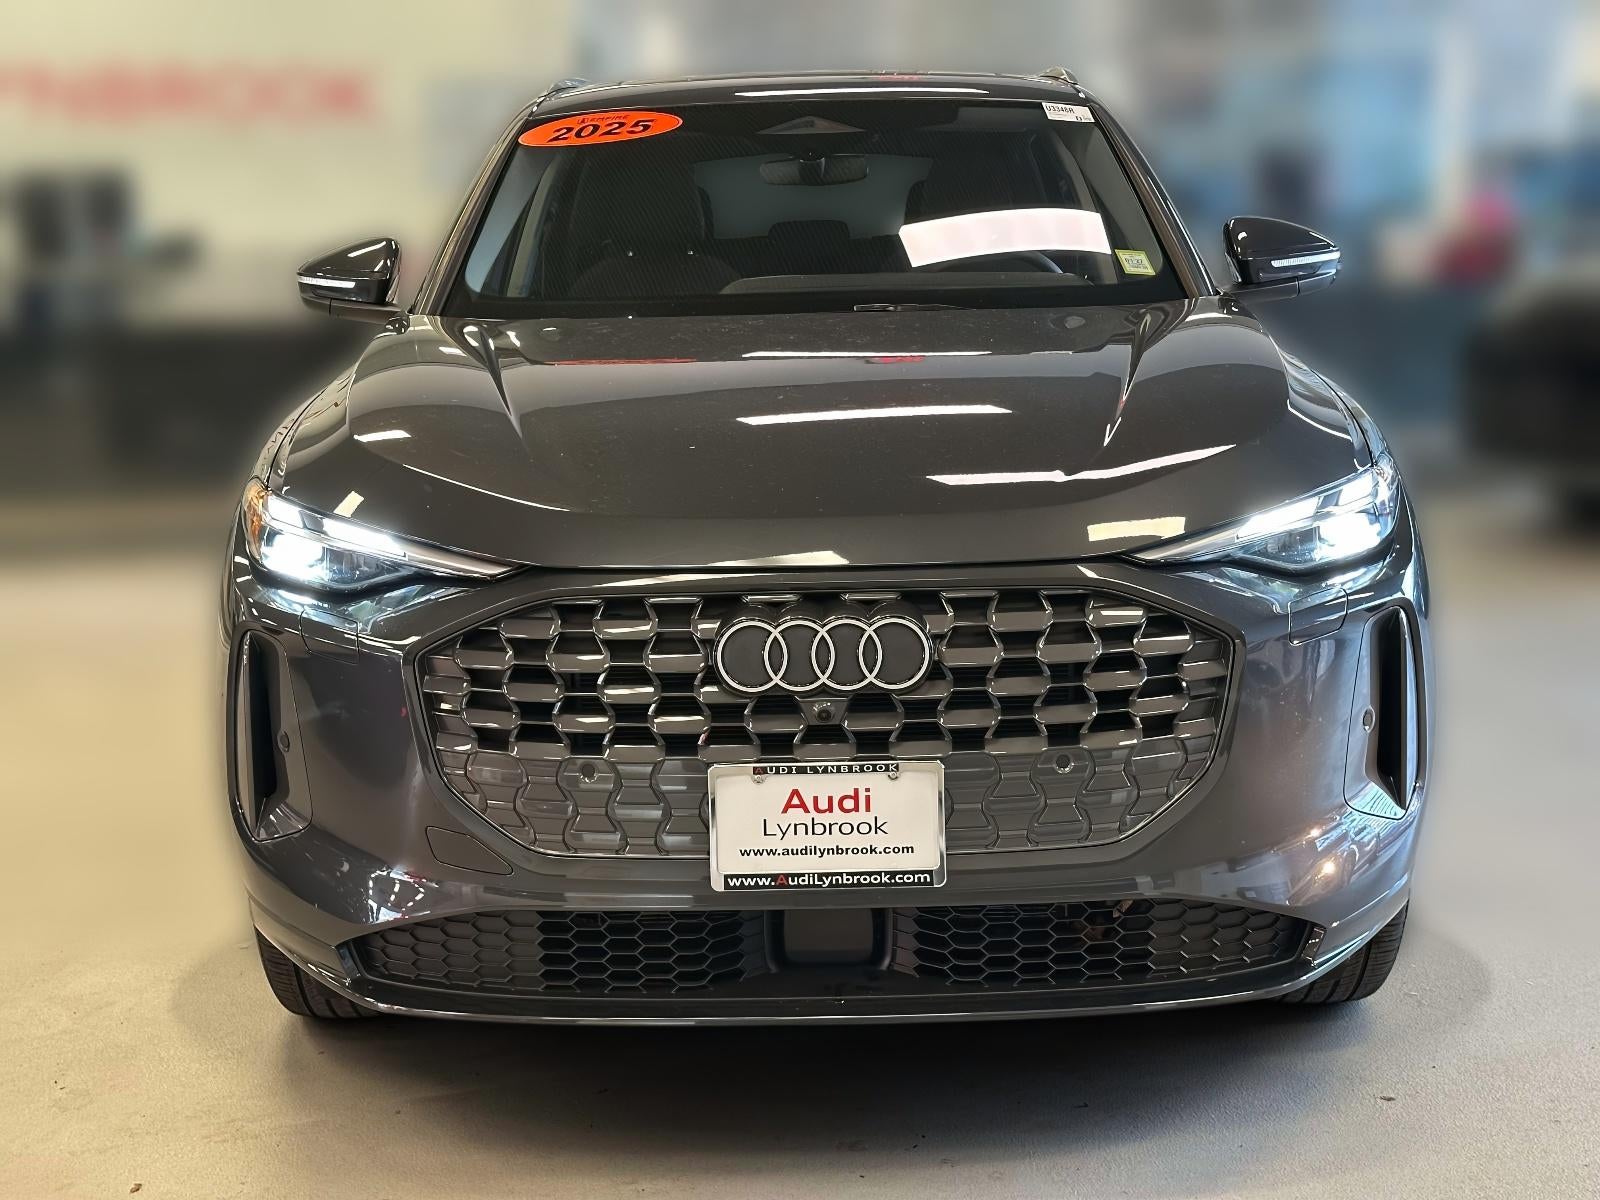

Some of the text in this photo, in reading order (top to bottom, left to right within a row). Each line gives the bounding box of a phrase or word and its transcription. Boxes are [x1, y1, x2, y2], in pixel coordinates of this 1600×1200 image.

[546, 119, 655, 143] 2025
[755, 764, 897, 775] AUDI LYNBROOK
[781, 788, 872, 814] Audi
[762, 816, 889, 840] Lynbrook
[739, 845, 915, 858] www.audilynbrook.com
[727, 872, 931, 888] www.AudiLynbrook.com
